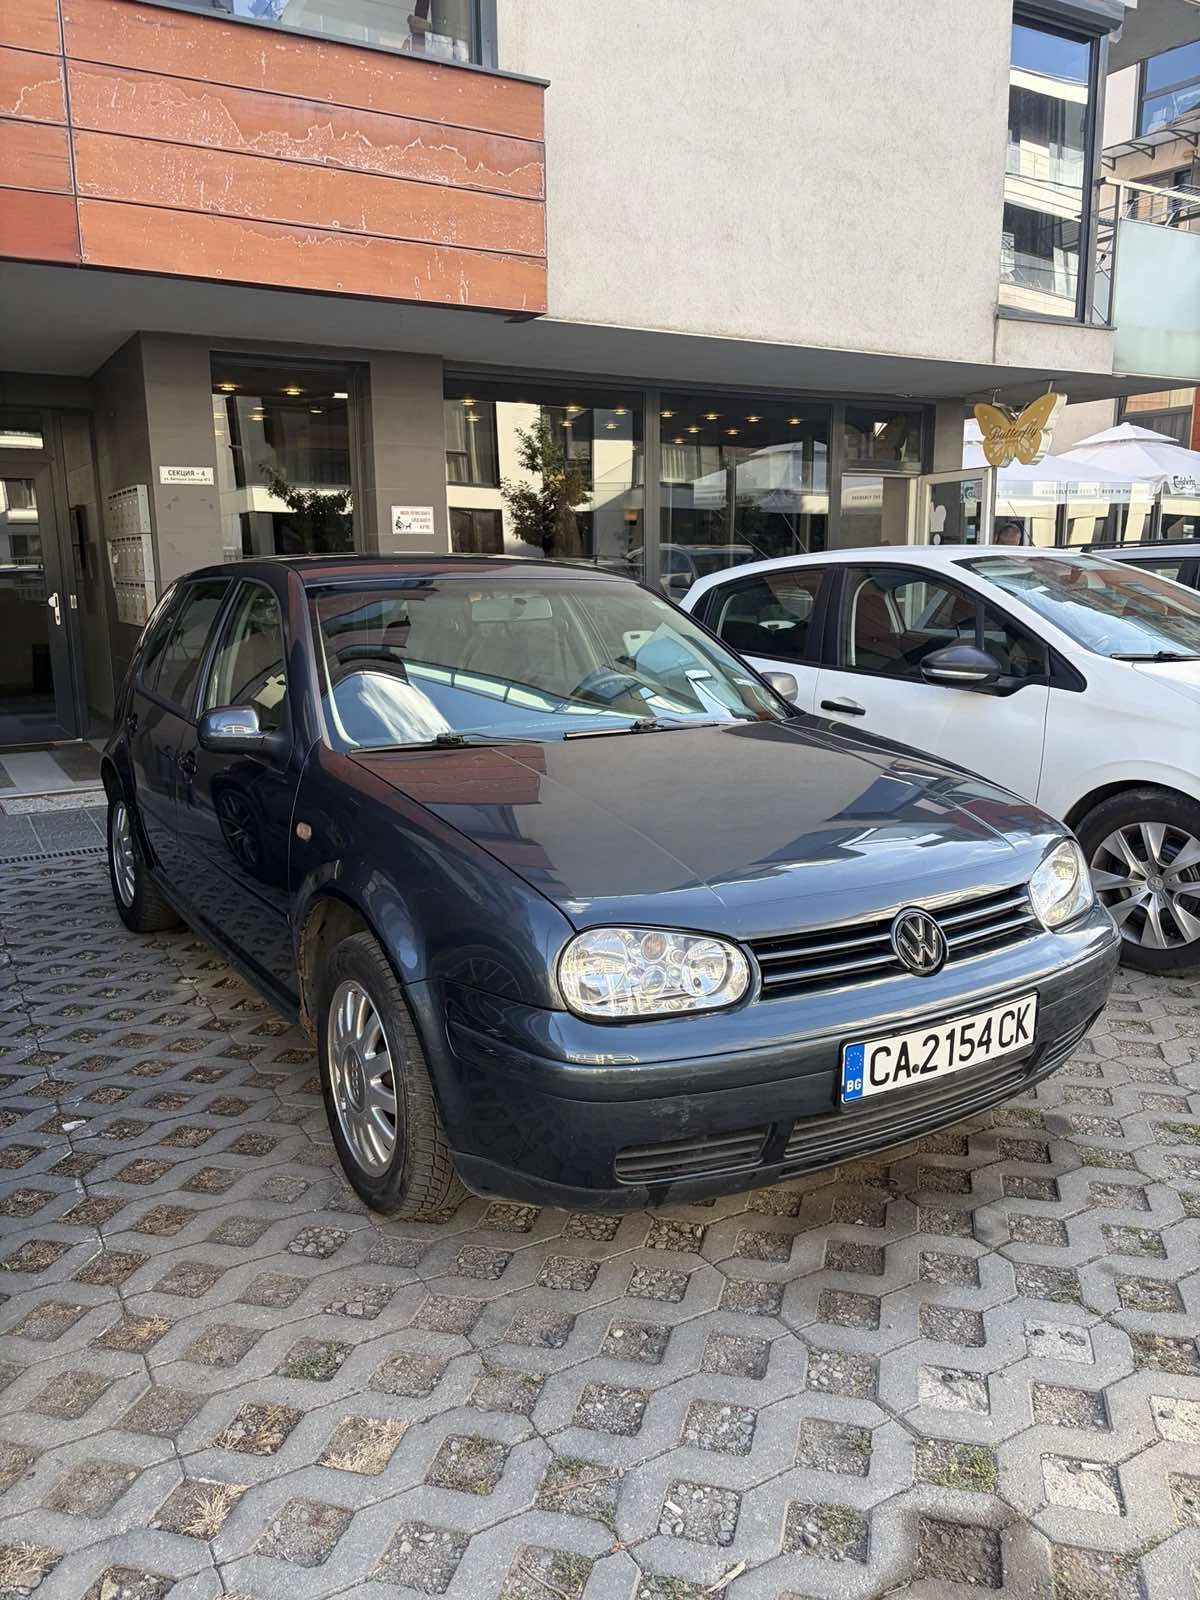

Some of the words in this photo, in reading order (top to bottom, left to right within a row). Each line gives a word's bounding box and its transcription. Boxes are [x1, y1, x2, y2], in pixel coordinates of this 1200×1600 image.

[990, 423, 1039, 440] Butterfly
[869, 1041, 912, 1086] CA
[919, 1016, 993, 1075] 2154
[998, 1003, 1032, 1048] CK
[846, 1078, 862, 1093] BG
